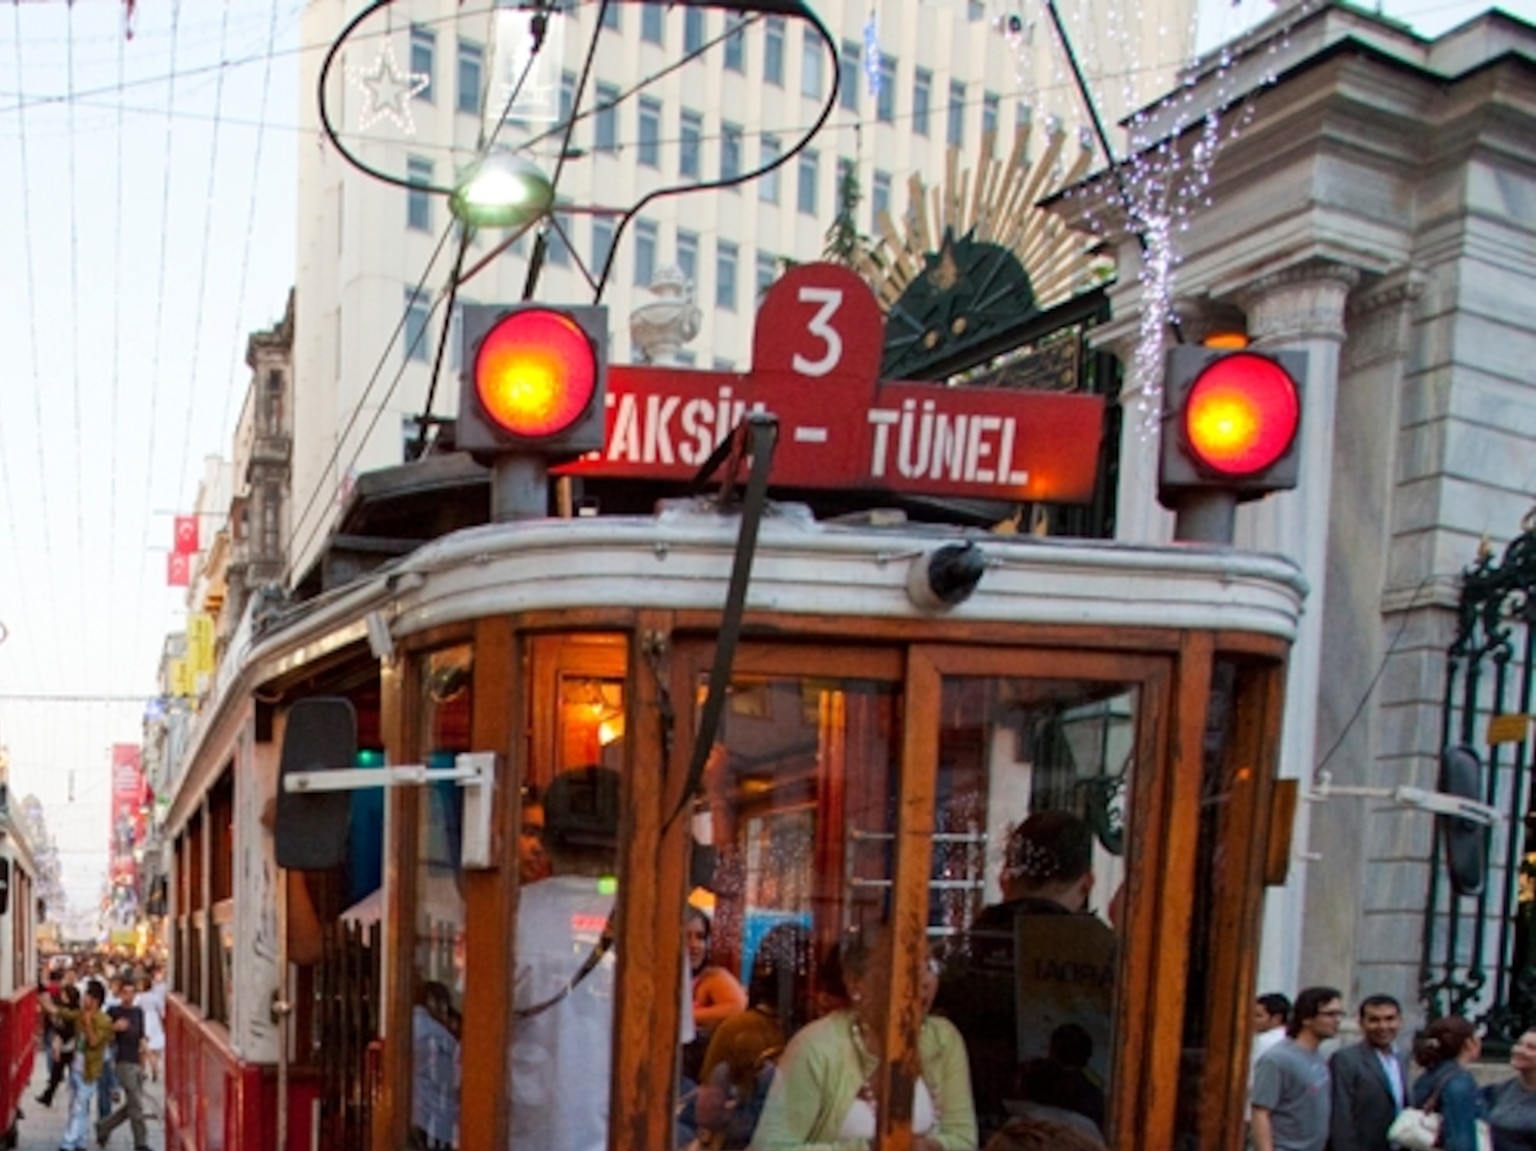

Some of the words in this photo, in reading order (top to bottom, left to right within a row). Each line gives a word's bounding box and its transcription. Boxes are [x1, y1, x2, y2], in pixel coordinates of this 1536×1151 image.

[792, 287, 843, 376] 3
[578, 386, 766, 470] AKSİ
[867, 400, 1029, 486] TÜNEL
